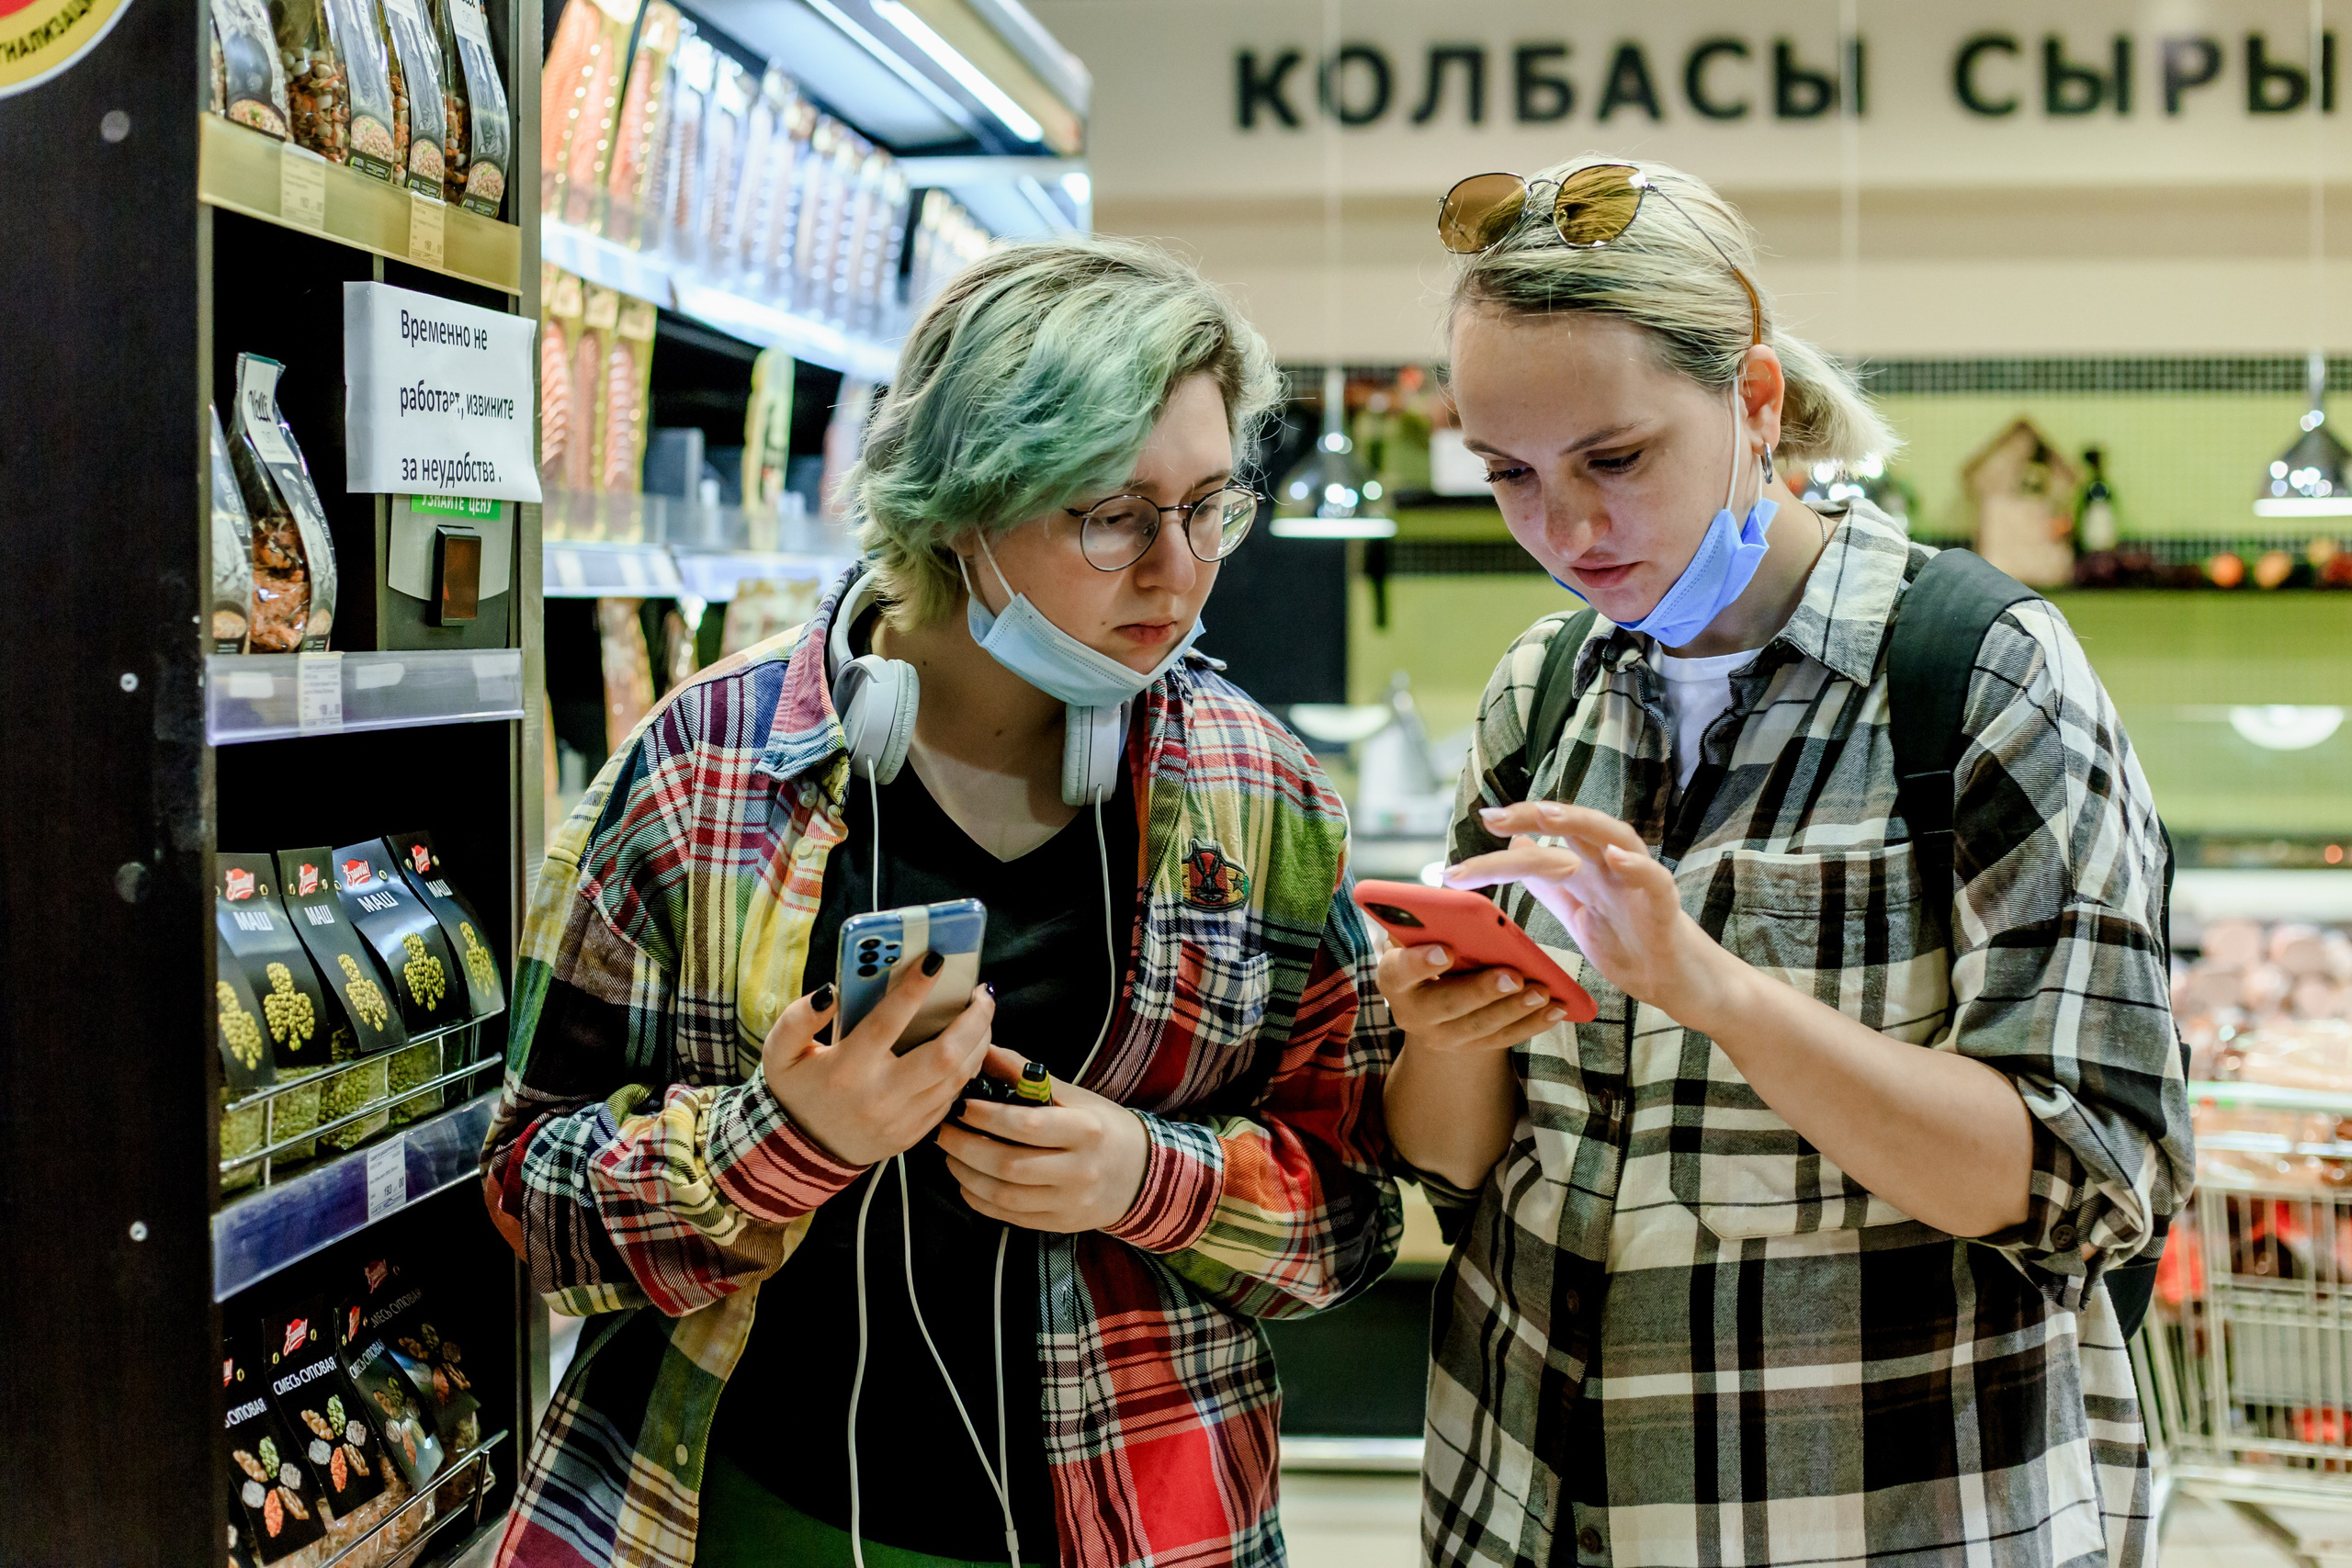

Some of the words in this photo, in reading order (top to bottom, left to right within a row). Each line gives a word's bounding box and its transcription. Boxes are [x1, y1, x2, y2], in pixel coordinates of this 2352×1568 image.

[1235, 37, 1867, 130] КОЛБАСЫ
[1953, 32, 2335, 118] СЫРЫ
[401, 309, 470, 348] Временно
[474, 327, 488, 351] не
[466, 392, 514, 420] извините
[401, 457, 418, 481] за
[425, 878, 454, 898] МАШ
[356, 890, 400, 913] МАШ
[232, 911, 275, 931] МАШ
[303, 904, 335, 927] МАШ
[370, 1308, 393, 1329] МЕСЬ
[273, 1373, 302, 1395] СМЕСЬ
[299, 1356, 338, 1383] СУПОВАЯ
[226, 1397, 267, 1426] СУПОВАЯ
